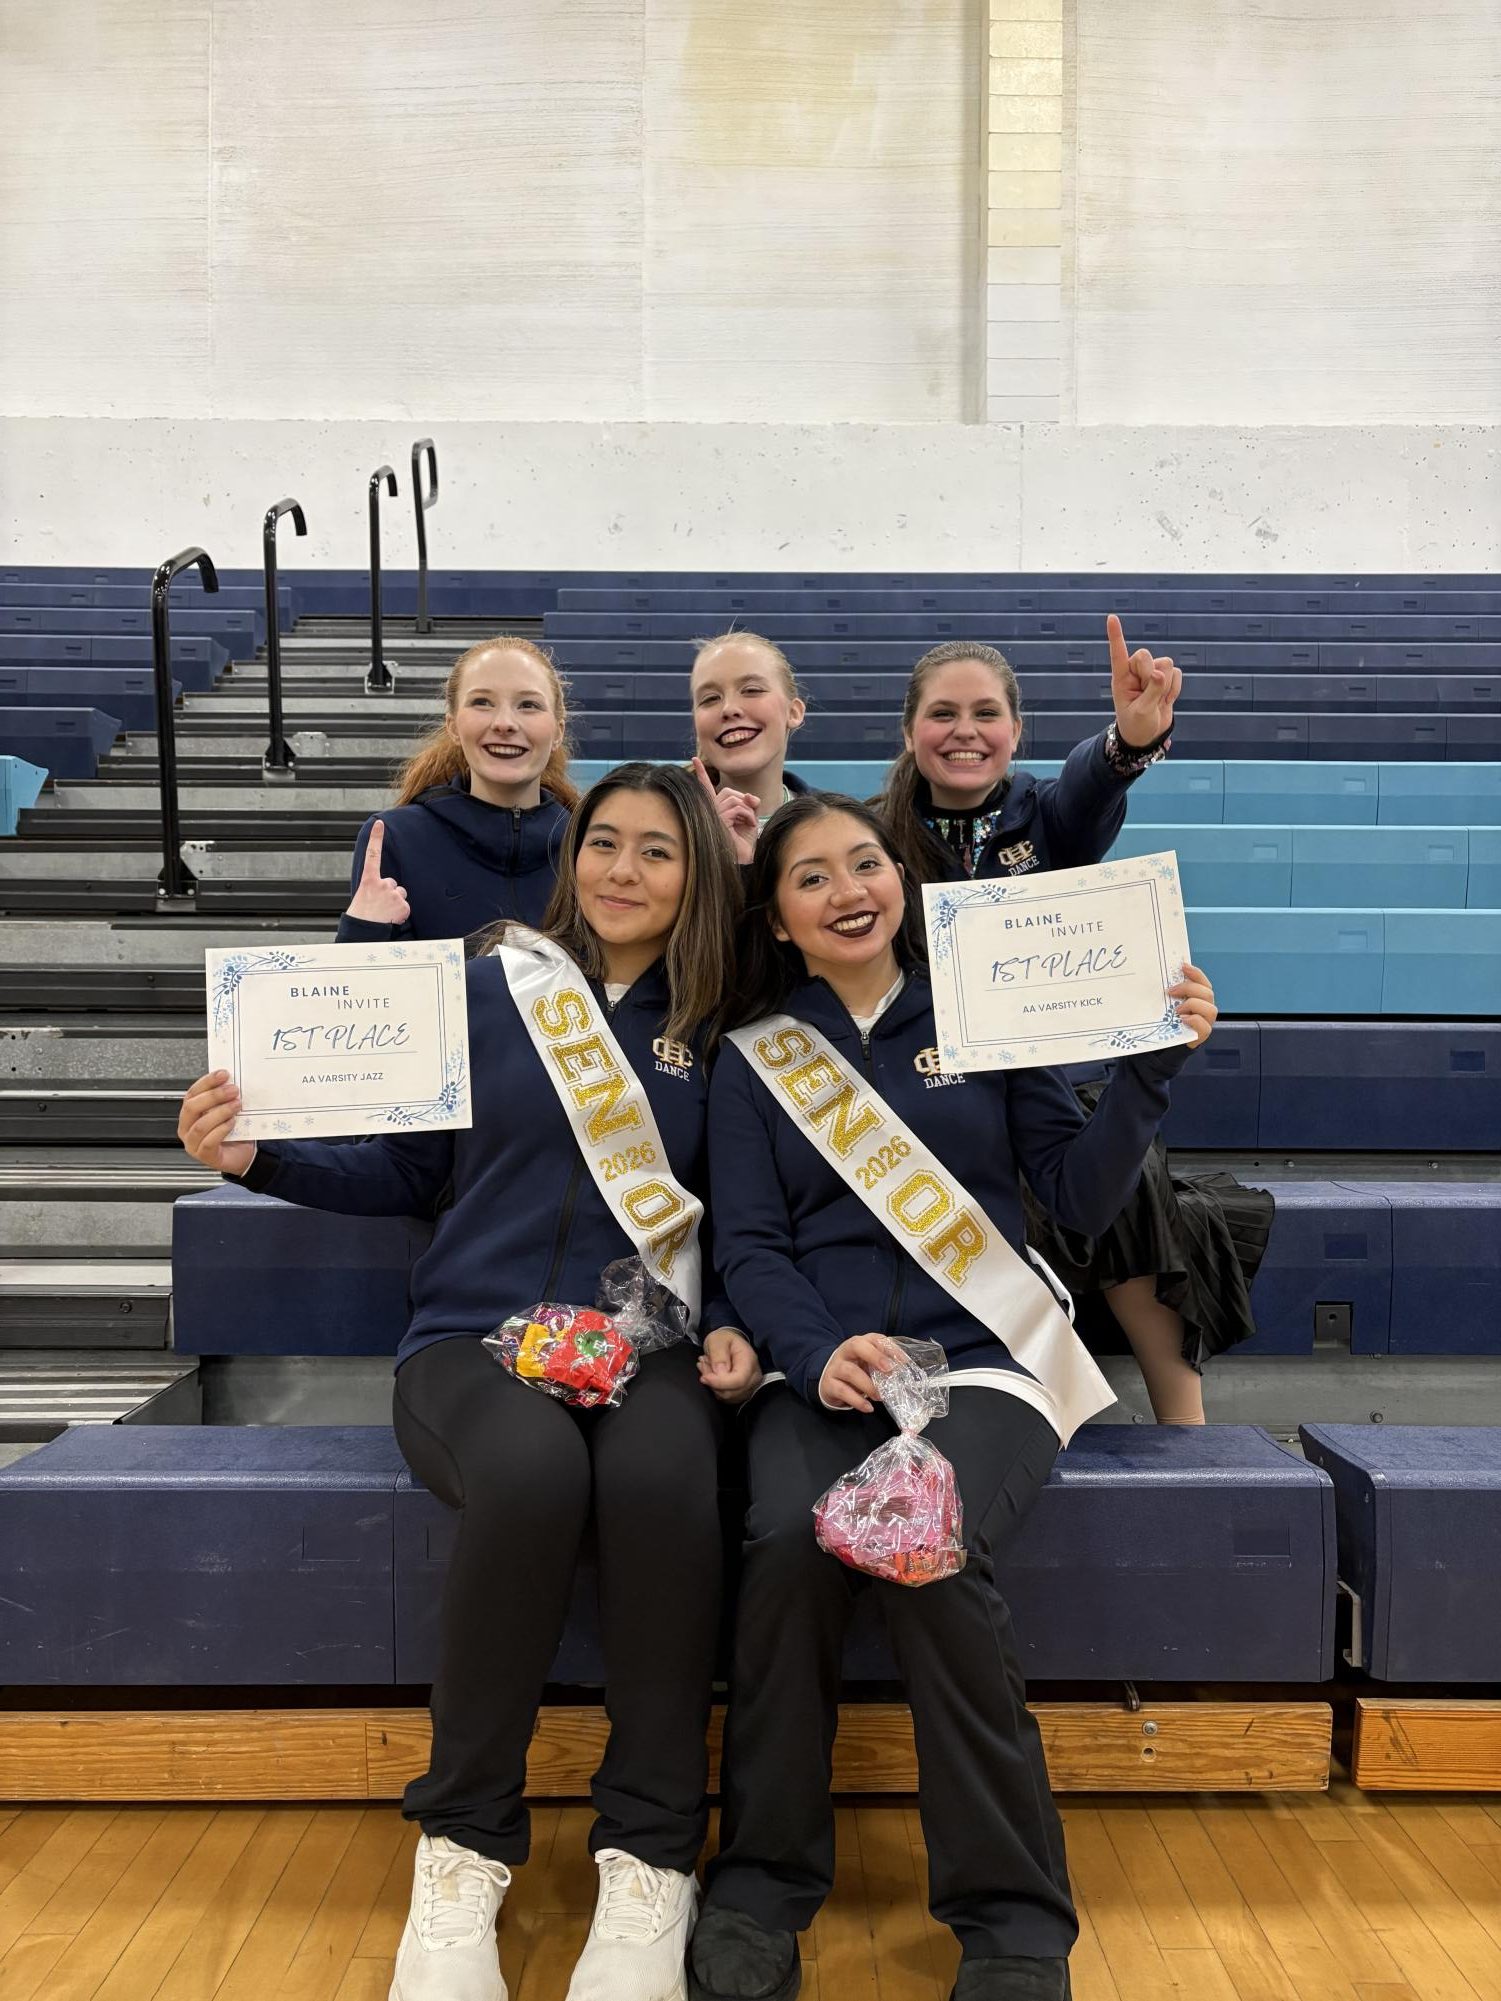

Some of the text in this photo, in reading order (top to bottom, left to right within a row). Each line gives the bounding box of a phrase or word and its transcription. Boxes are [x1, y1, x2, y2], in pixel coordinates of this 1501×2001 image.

[1008, 855, 1040, 876] DANCE
[1004, 913, 1063, 930] BLAINE
[1051, 921, 1104, 938] INVITE
[991, 944, 1127, 983] 1ST PLACE
[290, 985, 350, 998] BLAINE
[337, 997, 390, 1010] INVITE
[1022, 997, 1103, 1014] AA VARSITY KICK
[272, 1022, 410, 1051] 1ST PLACE
[301, 1072, 384, 1084] AA VARSITY JAZZ
[654, 1060, 690, 1082] DANCE
[923, 1072, 966, 1089] DANCE
[599, 1141, 656, 1182] 2026
[855, 1135, 912, 1190] 2026
